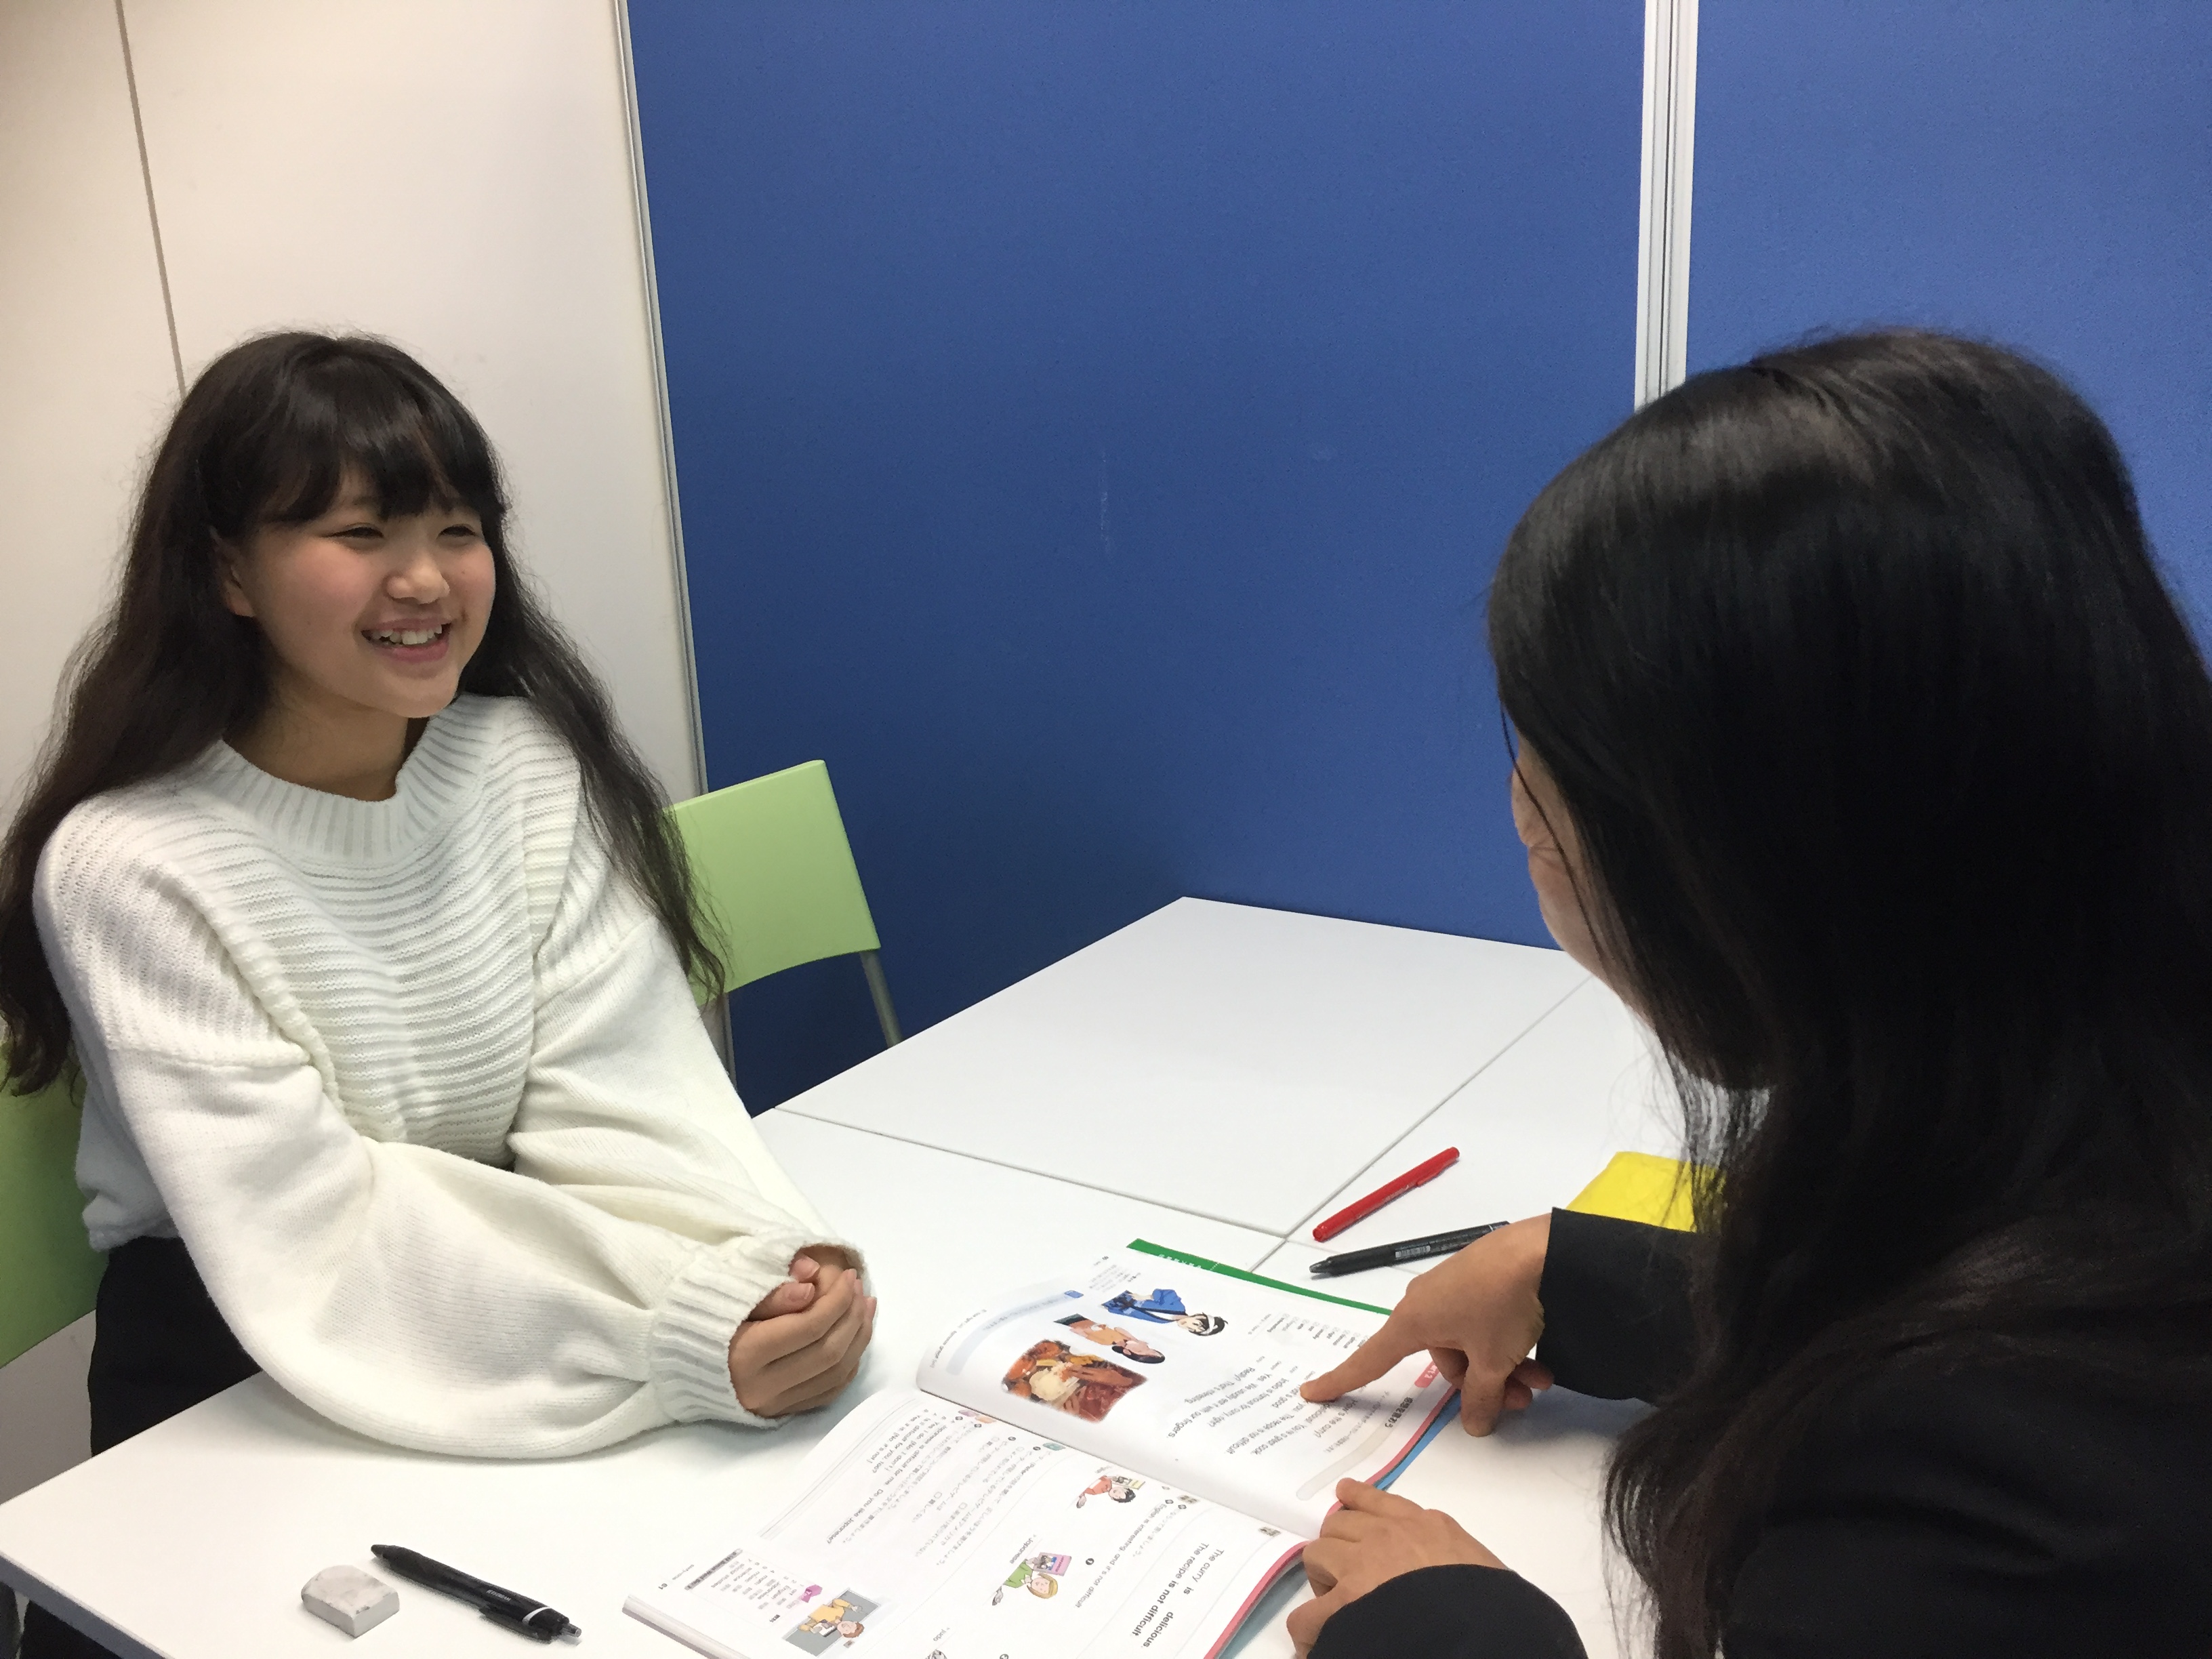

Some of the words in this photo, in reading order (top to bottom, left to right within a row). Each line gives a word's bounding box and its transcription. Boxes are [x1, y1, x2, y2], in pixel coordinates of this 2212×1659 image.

[863, 1497, 874, 1507] you
[854, 1508, 865, 1517] like
[1010, 1538, 1033, 1563] Japanese
[1194, 1543, 1209, 1555] The
[1208, 1549, 1224, 1561] The
[1109, 1554, 1120, 1565] and
[1102, 1566, 1111, 1574] it's
[1176, 1556, 1195, 1578] recipe
[1192, 1563, 1210, 1582] curry
[1094, 1576, 1103, 1586] not
[1158, 1589, 1170, 1603] not
[933, 1629, 946, 1641] judo
[1143, 1612, 1173, 1647] delicious.
